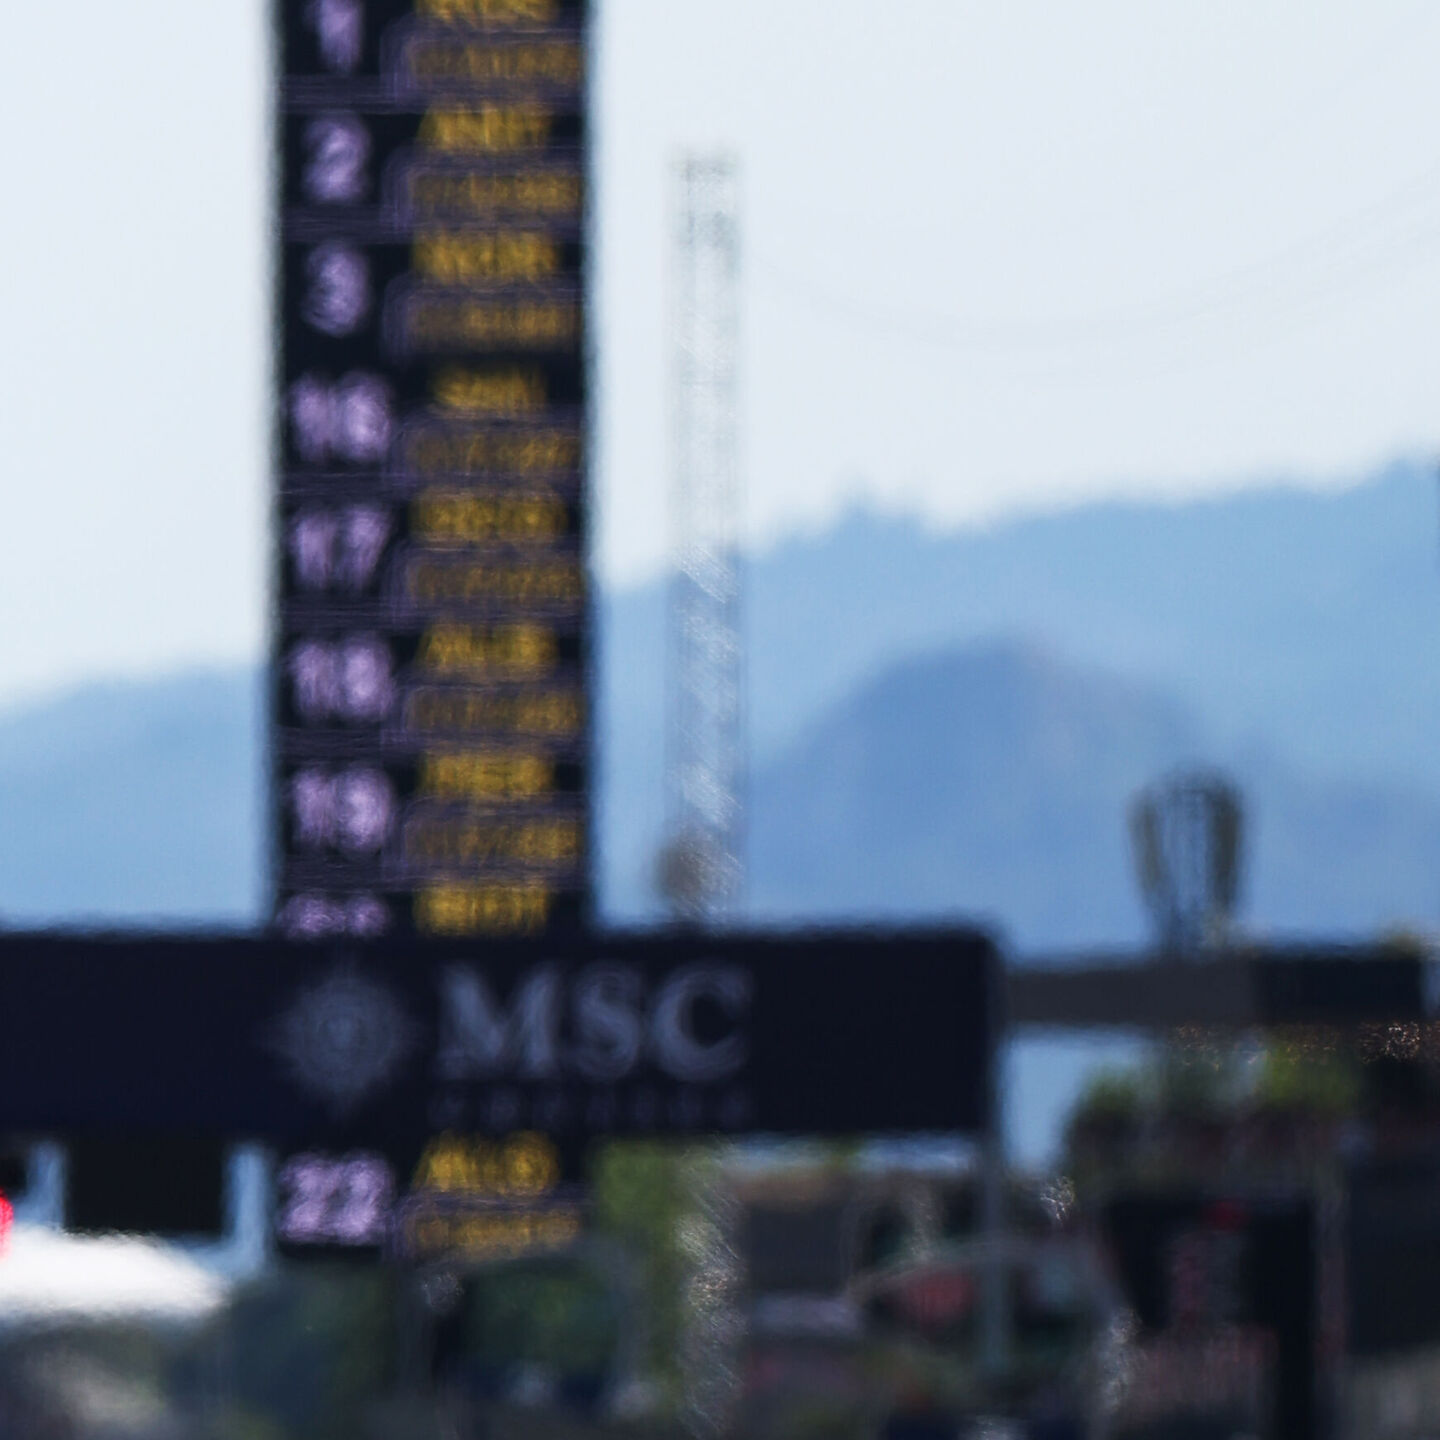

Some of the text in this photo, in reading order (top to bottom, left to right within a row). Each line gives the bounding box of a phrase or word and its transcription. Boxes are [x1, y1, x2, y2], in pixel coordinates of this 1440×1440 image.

[303, 114, 371, 204] 2
[303, 240, 371, 336] 3
[291, 371, 392, 461] 16
[291, 507, 390, 589] 17
[291, 635, 395, 723] 18
[291, 766, 395, 853] 19
[440, 963, 750, 1081] MSC
[280, 1152, 392, 1243] 22
